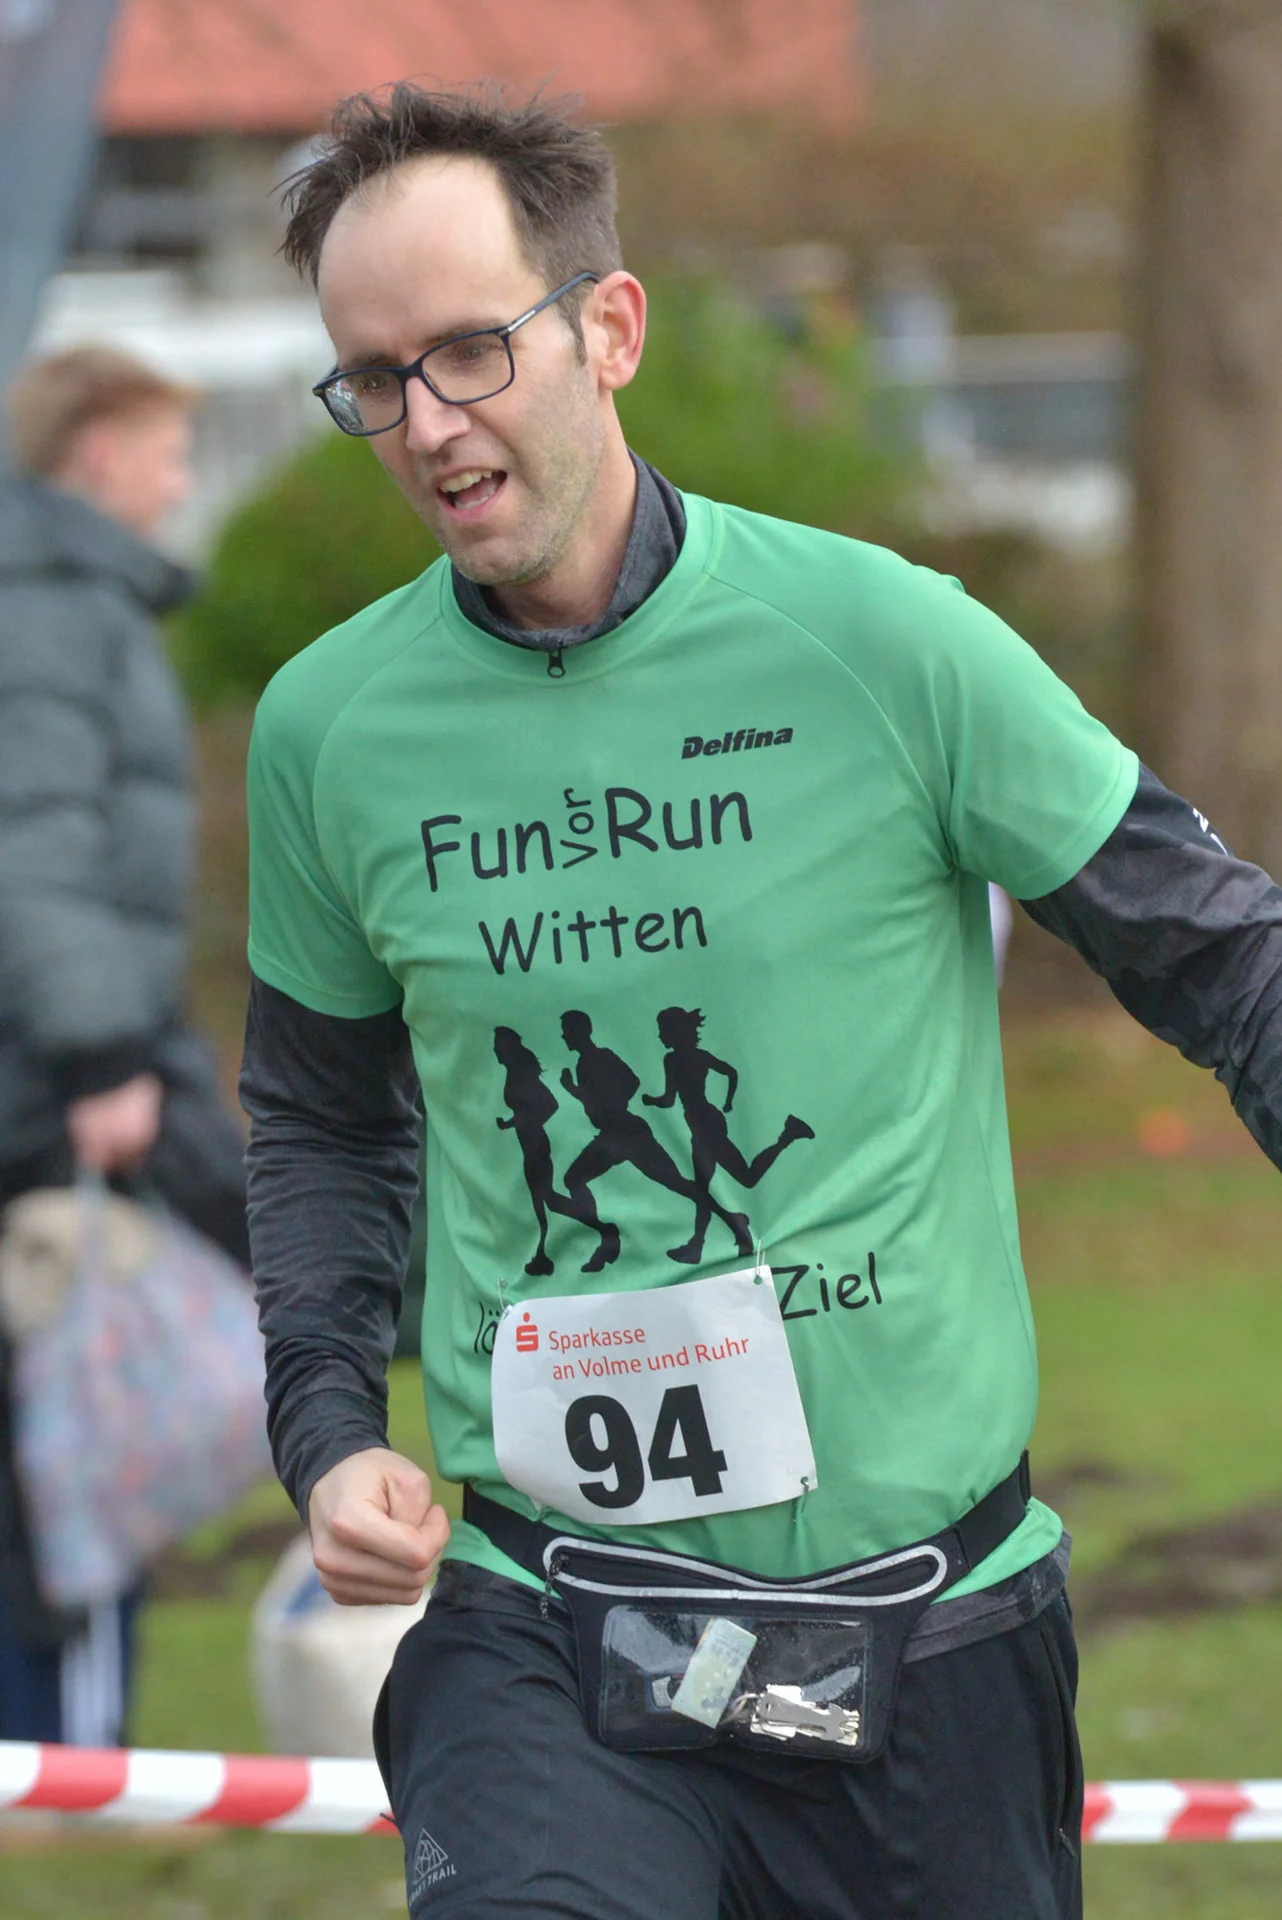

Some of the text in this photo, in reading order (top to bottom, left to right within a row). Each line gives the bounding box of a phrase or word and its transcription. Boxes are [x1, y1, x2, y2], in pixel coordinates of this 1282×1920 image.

[682, 727, 794, 760] Delfina
[420, 786, 753, 893] Fun vor Run
[478, 905, 708, 976] Witten
[771, 1251, 883, 1321] Ziel
[548, 1326, 646, 1352] Sparkasse
[553, 1335, 751, 1381] an Volme und Ruhr
[564, 1384, 729, 1510] 94
